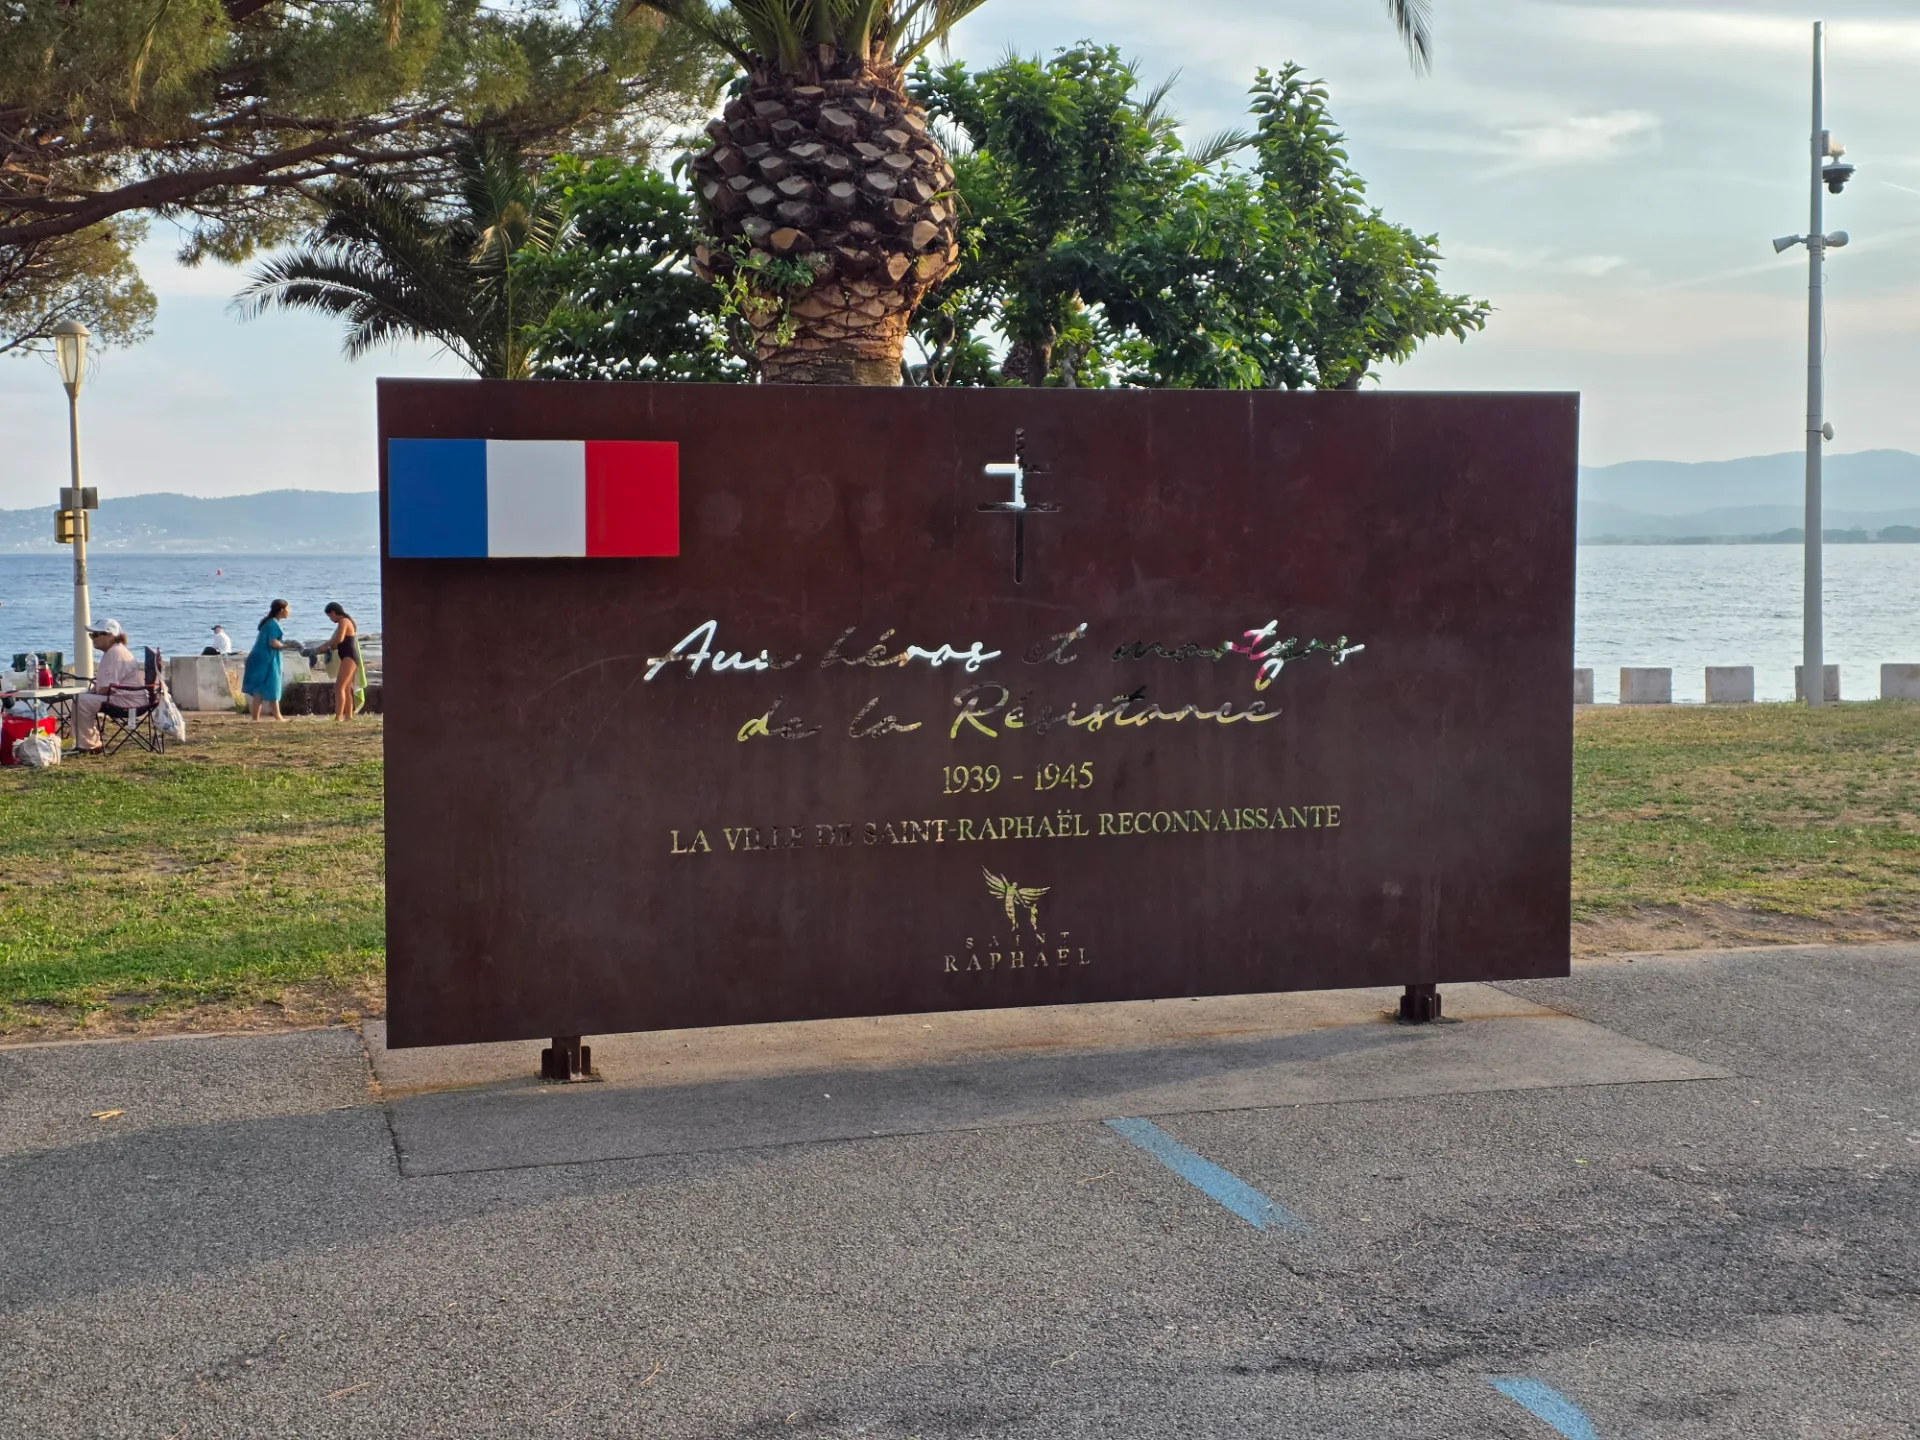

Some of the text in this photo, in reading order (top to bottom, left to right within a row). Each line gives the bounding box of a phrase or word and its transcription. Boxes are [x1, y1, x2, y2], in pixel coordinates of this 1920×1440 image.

[736, 694, 823, 742] de
[848, 696, 922, 738] la
[942, 764, 1001, 794] 1939
[1034, 761, 1093, 791] 1945
[670, 804, 1342, 854] LA VILLE DE SAINT-RAPHAËL RECONNAISSANTE
[965, 931, 1070, 949] SAINT
